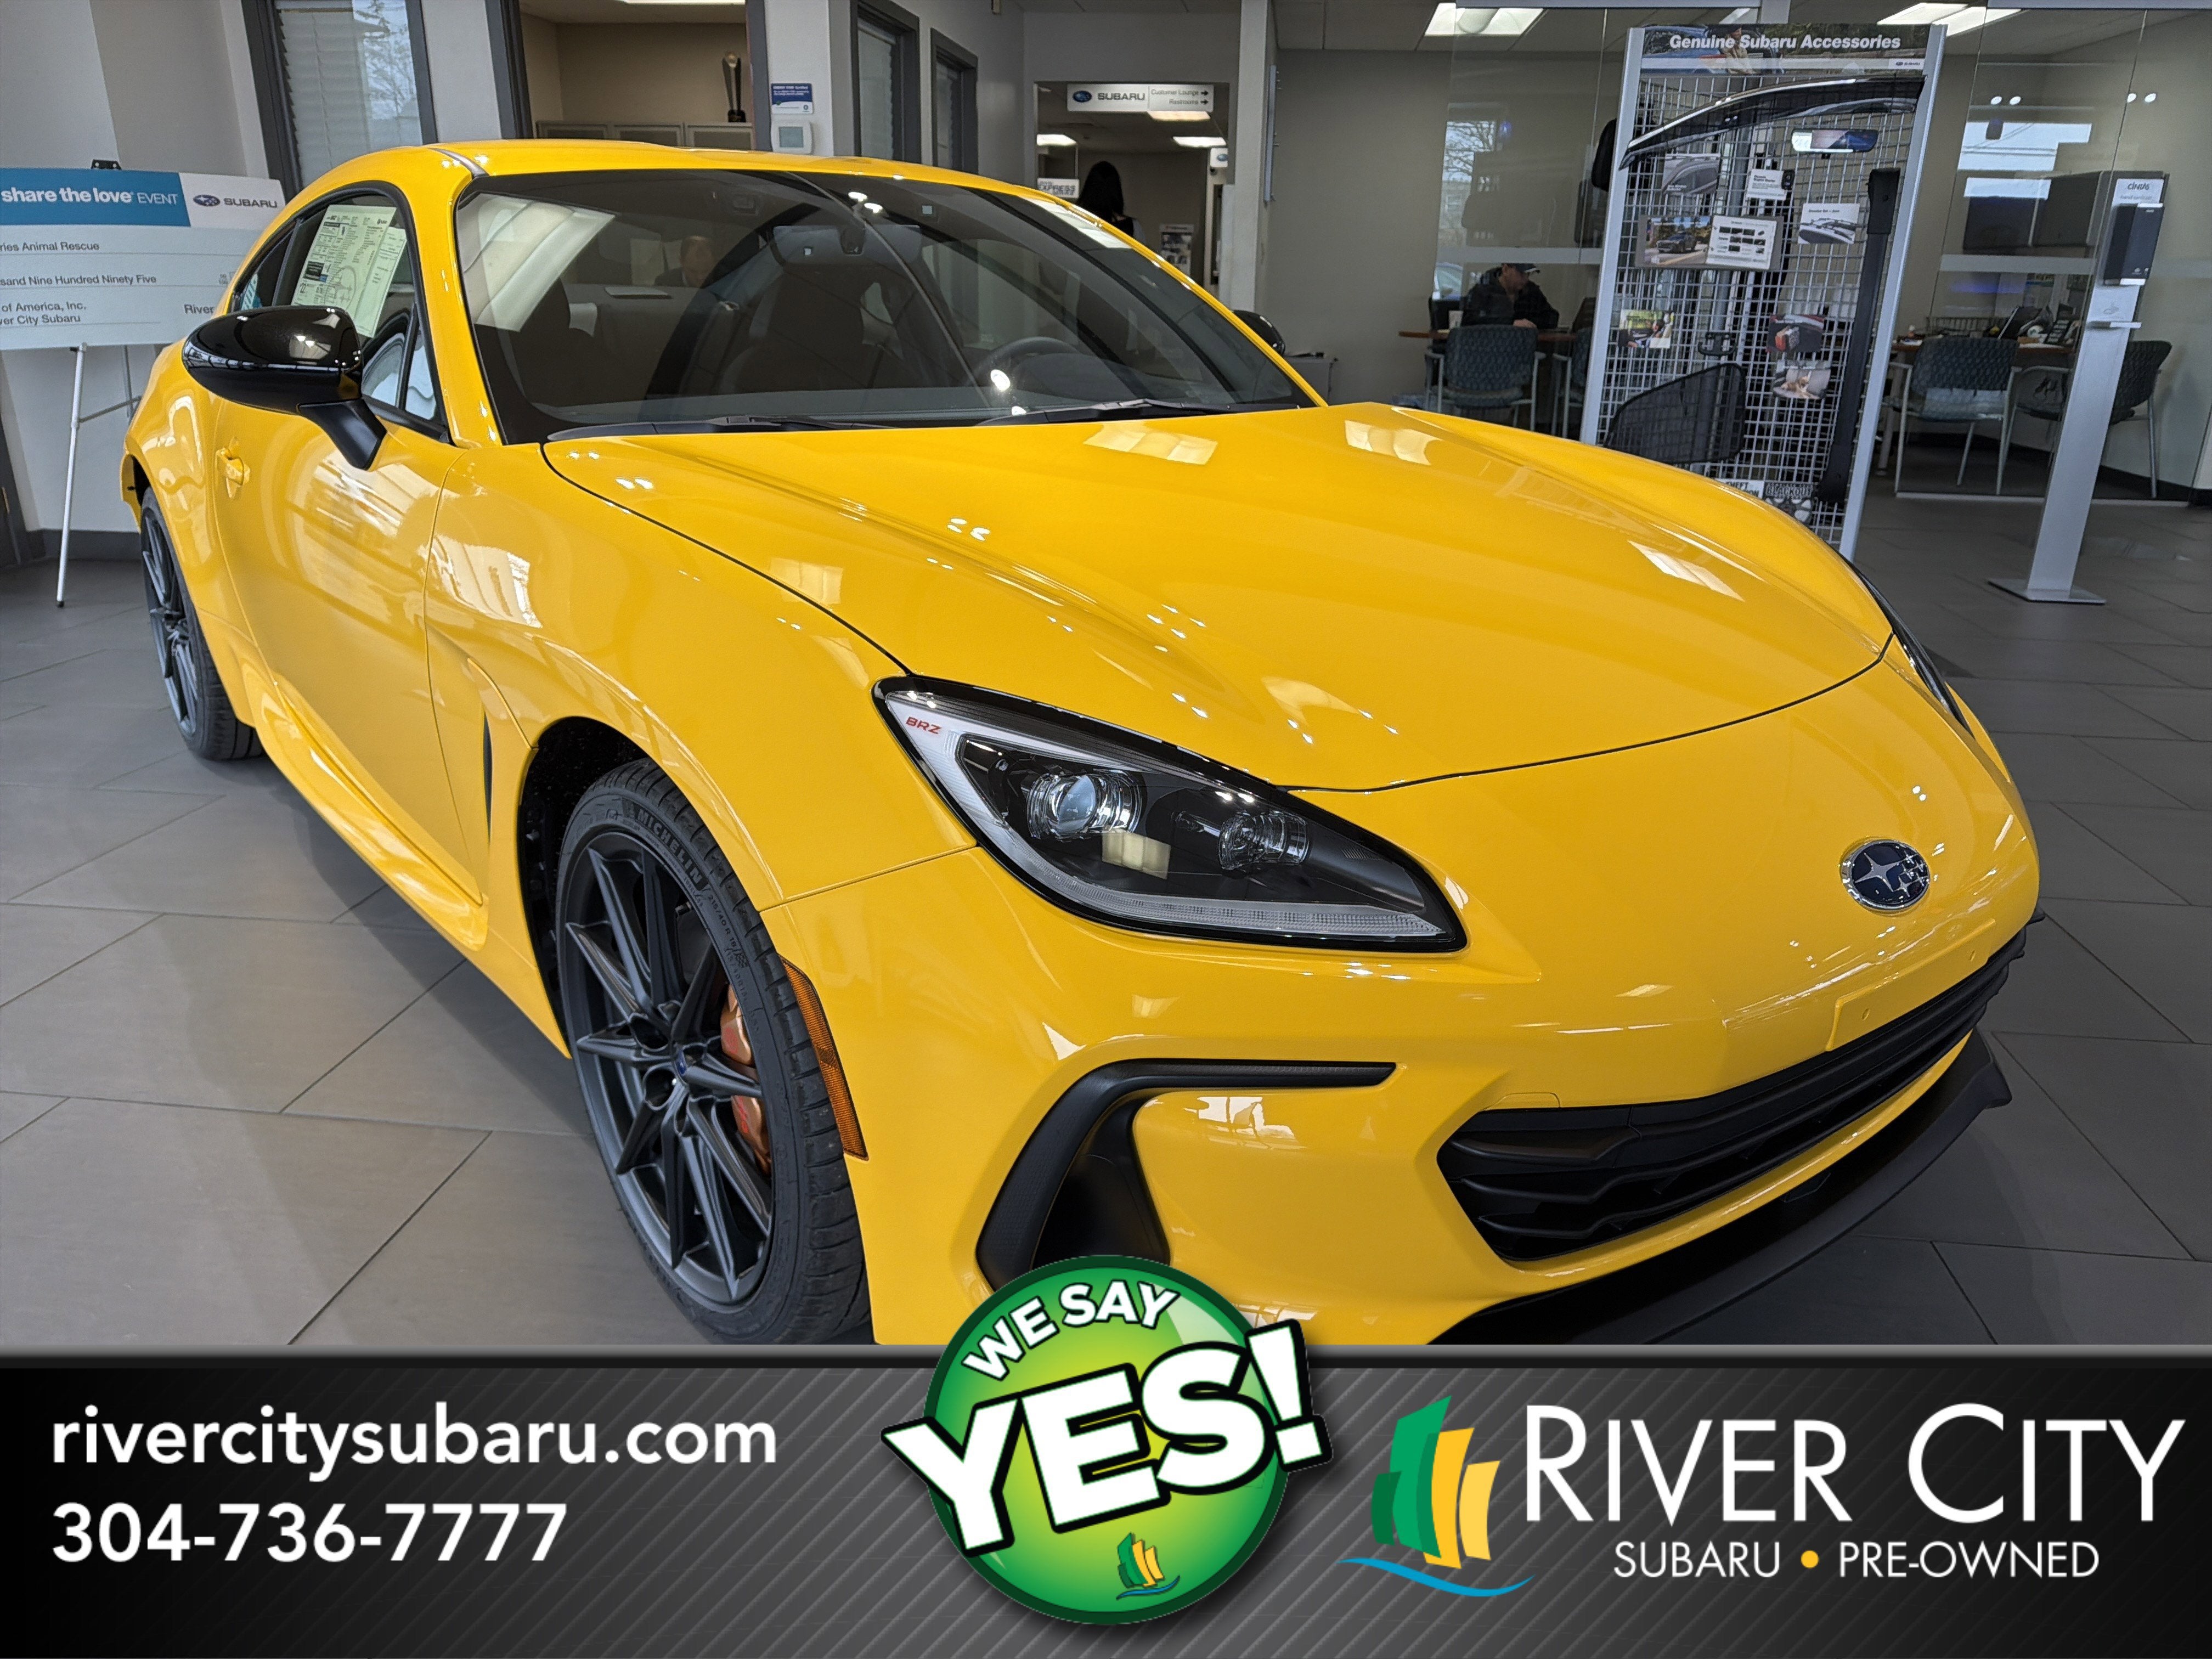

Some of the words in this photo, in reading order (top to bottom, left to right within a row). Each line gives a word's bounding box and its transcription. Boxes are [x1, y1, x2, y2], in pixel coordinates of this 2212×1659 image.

[1669, 35, 1735, 49] Genuine
[1740, 35, 1796, 49] Subaru
[1801, 34, 1901, 49] Accessories
[1097, 93, 1146, 101] SUBARU
[2, 187, 57, 202] share
[59, 187, 92, 202] the
[93, 187, 132, 203] love
[137, 192, 178, 205] EVENT
[224, 198, 278, 208] SUBARU
[22, 241, 58, 251] Animal
[60, 241, 99, 251] Rescue
[0, 276, 26, 286] sand
[29, 275, 53, 285] Nine
[55, 275, 99, 284] Hundred
[101, 274, 133, 286] Ninety
[136, 274, 157, 283] Five
[1, 302, 12, 312] of
[15, 301, 64, 312] America,
[66, 301, 86, 311] Inc.
[184, 304, 215, 314] River
[17, 315, 38, 326] City
[42, 314, 81, 324] Subaru
[905, 716, 942, 735] BRZ
[637, 808, 703, 884] MICHELIN
